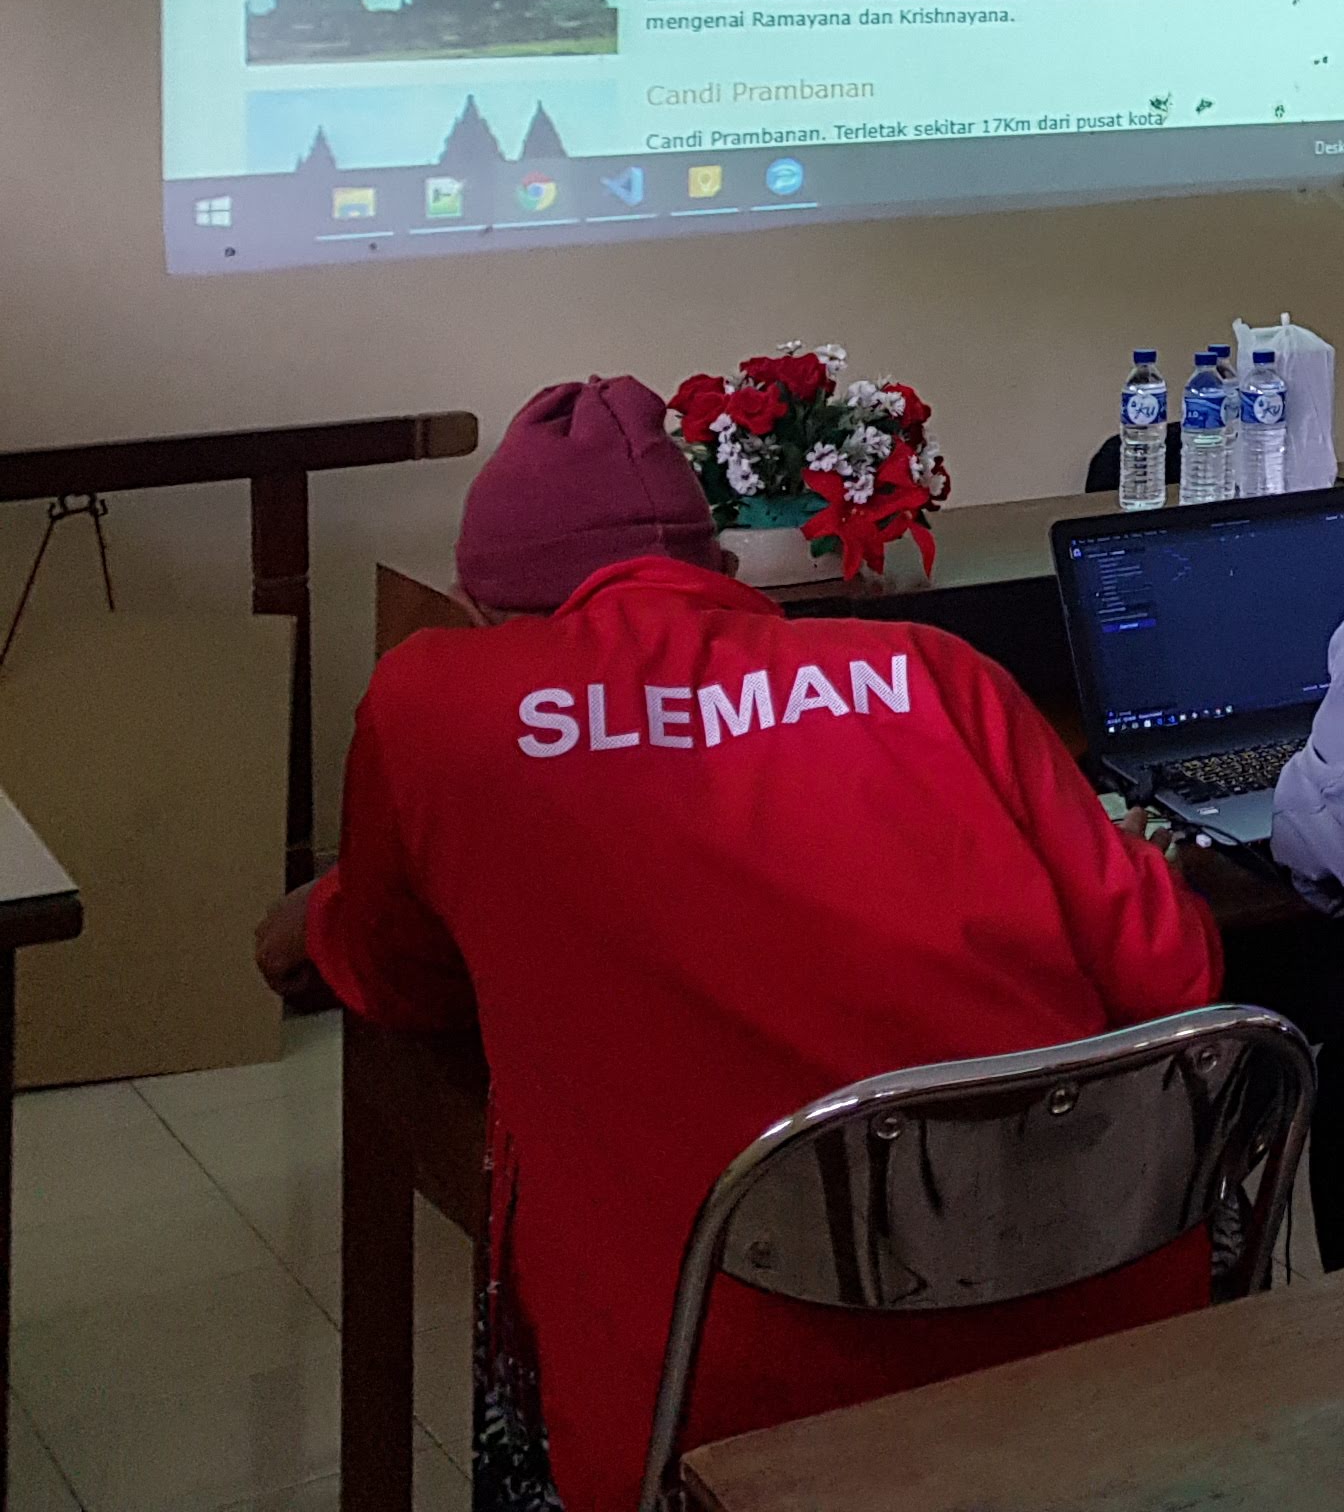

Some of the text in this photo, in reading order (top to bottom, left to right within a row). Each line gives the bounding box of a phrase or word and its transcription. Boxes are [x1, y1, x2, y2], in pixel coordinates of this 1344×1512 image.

[646, 6, 1016, 33] mengenai Ramayana dan Krishnayana.
[647, 78, 873, 106] Candi Prambanan
[646, 111, 1163, 150] Candi Prambanan. Terletak sekitar 17Km dari pusat kota
[517, 654, 910, 758] SLEMAN
